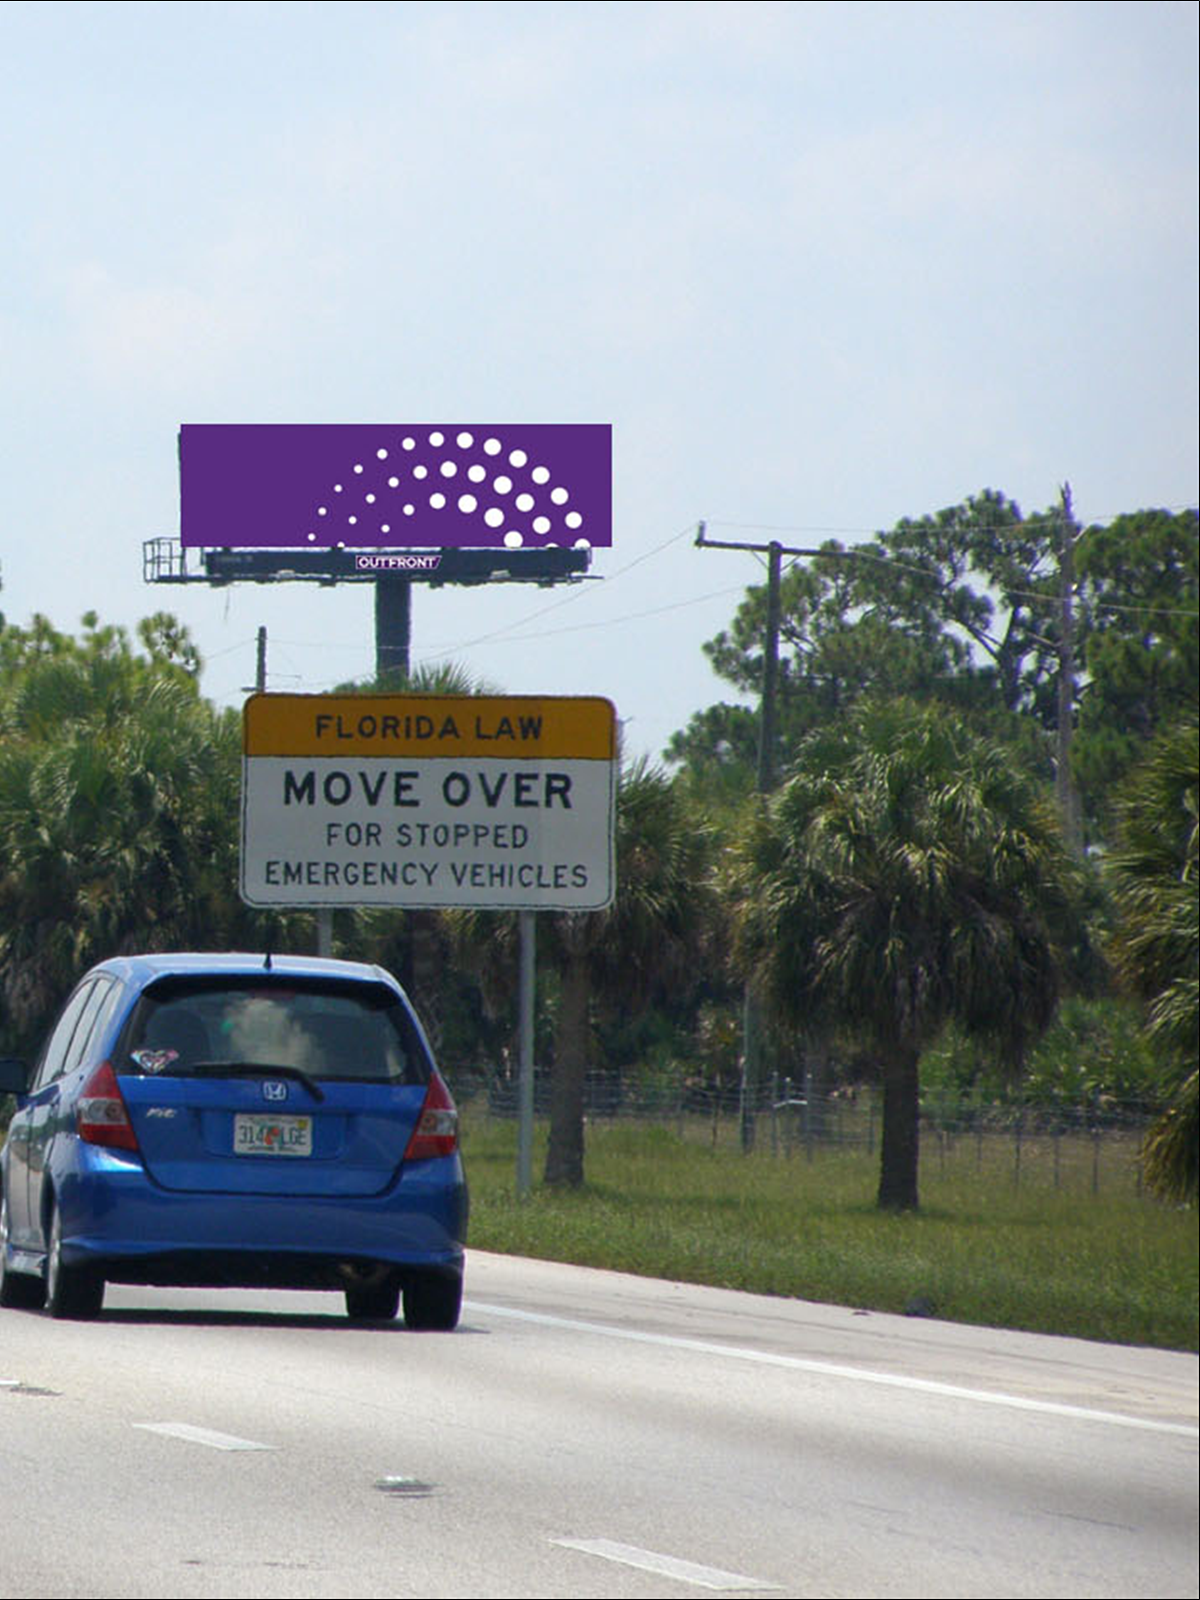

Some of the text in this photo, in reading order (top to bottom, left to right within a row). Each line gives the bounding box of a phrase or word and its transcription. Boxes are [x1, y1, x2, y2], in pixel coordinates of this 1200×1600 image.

[358, 556, 436, 568] OUTFRONT
[315, 714, 543, 741] FLORIDA LAW
[282, 771, 574, 809] MOVE OVER
[326, 823, 529, 849] FOR STOPPED
[265, 860, 588, 889] EMERGENCY VEHICLES
